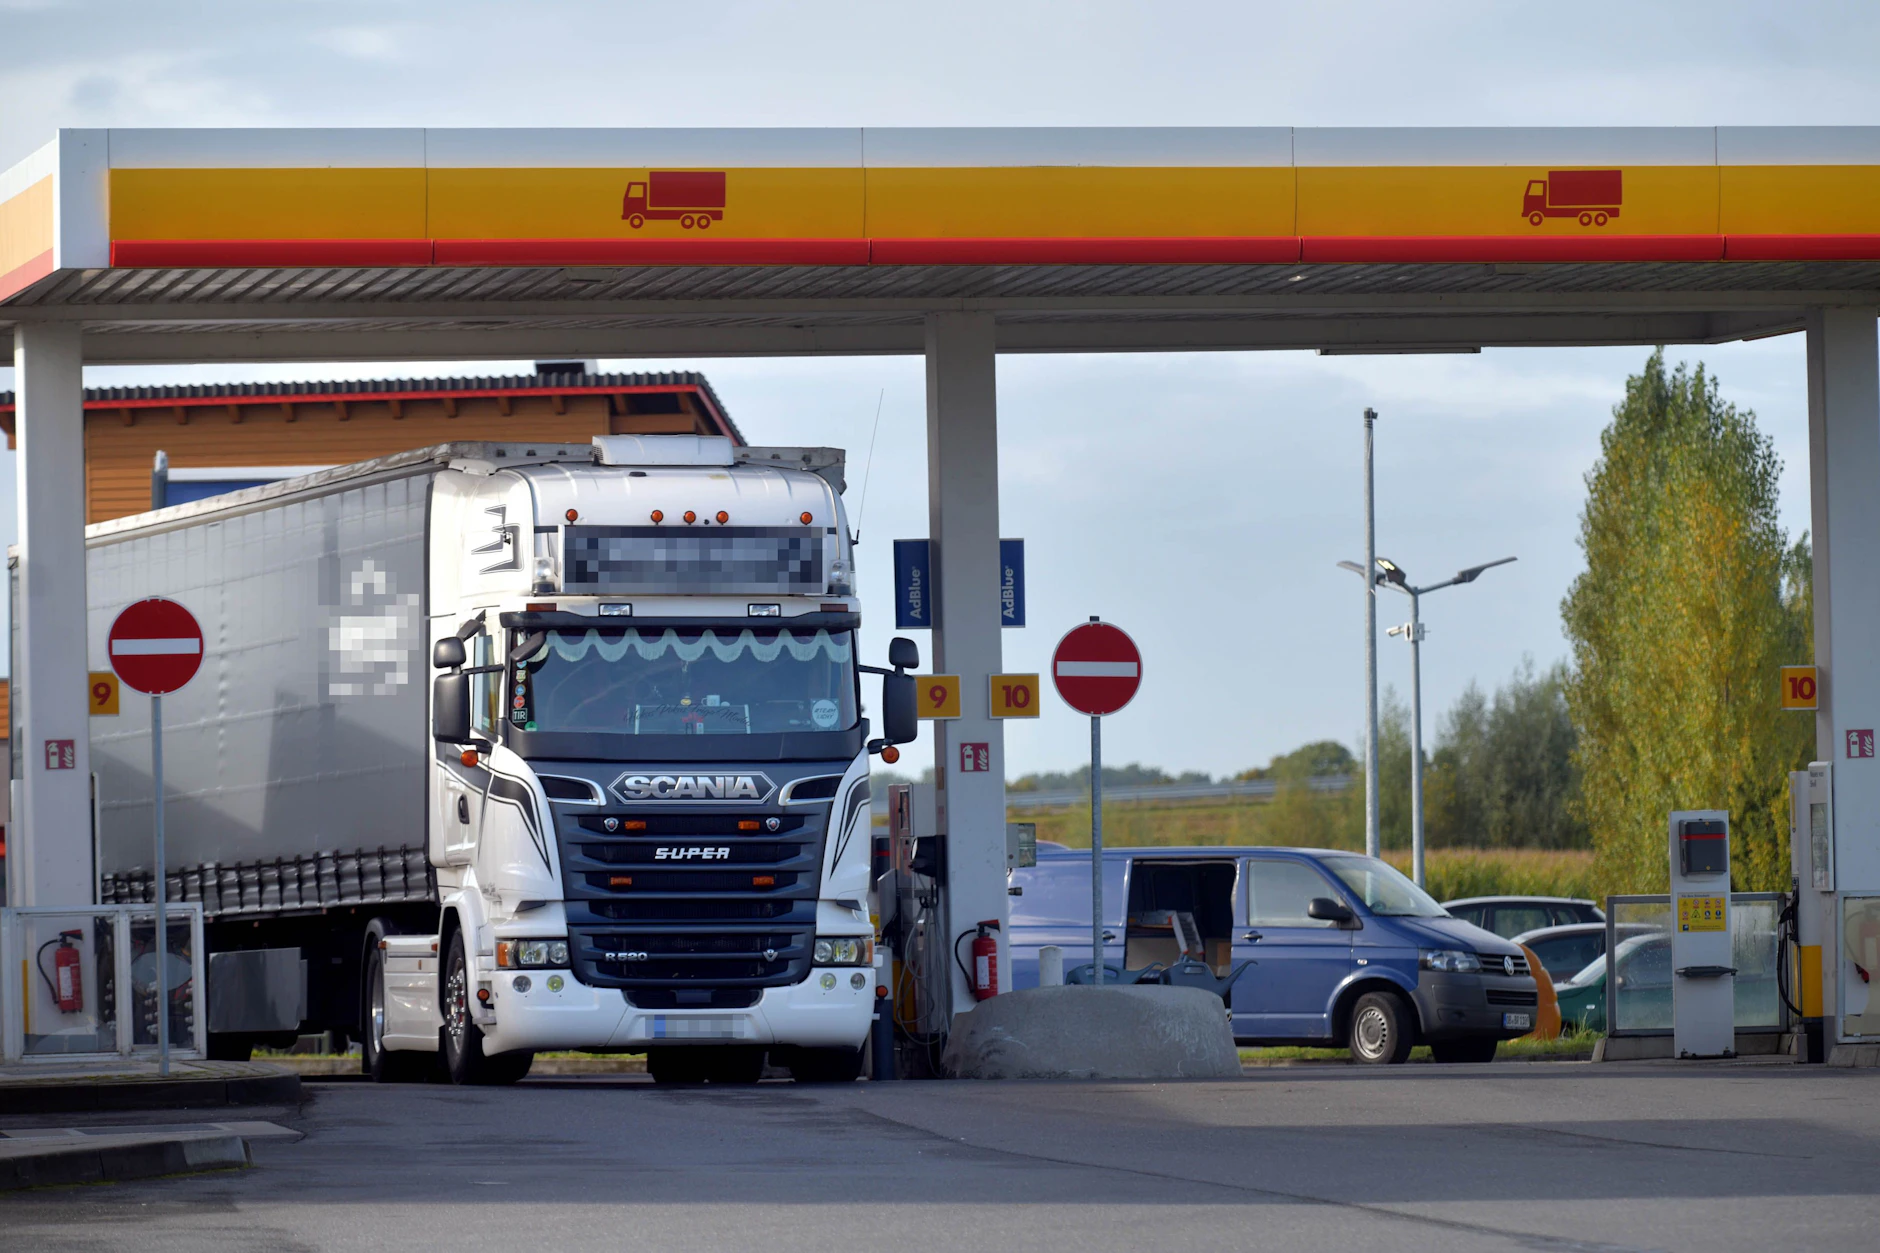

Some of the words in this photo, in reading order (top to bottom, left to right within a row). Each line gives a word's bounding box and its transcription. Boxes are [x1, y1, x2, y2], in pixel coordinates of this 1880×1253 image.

[908, 567, 922, 619] AdBlue
[1001, 567, 1015, 619] AdBlue
[92, 682, 111, 706] 9
[929, 685, 948, 709] 9
[1002, 684, 1031, 709] 10
[1788, 676, 1816, 700] 10
[513, 710, 527, 721] TIR
[623, 775, 760, 799] SCANIA
[655, 847, 730, 860] SUPER
[605, 952, 616, 961] R
[617, 952, 648, 961] 520
